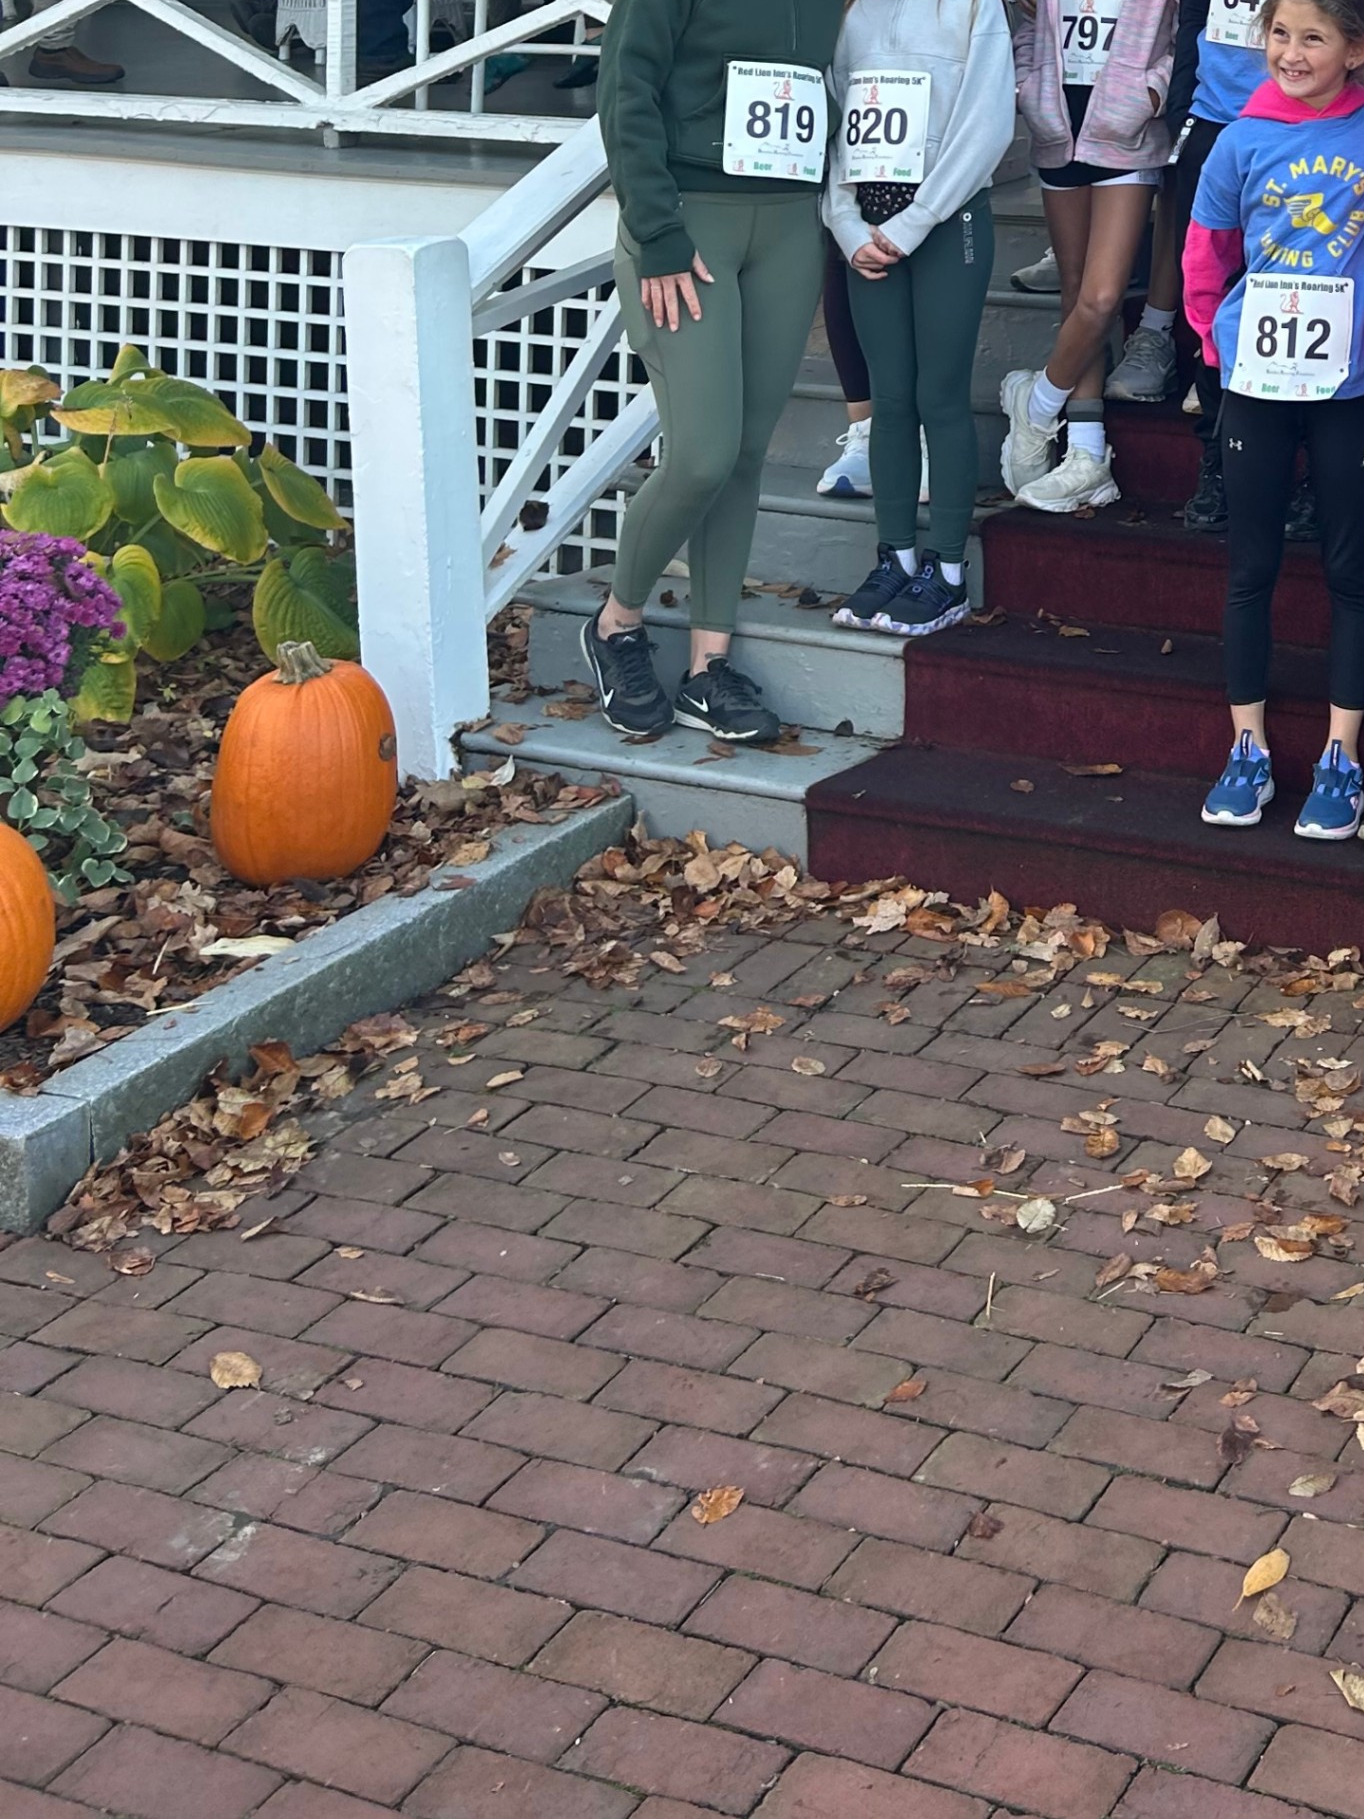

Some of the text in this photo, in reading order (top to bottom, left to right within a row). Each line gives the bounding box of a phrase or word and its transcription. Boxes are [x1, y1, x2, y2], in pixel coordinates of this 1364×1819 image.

[1062, 15, 1118, 52] 797
[746, 100, 815, 143] 819
[846, 107, 908, 146] 820
[893, 167, 912, 177] Food
[1262, 178, 1287, 208] ST.
[1301, 281, 1334, 293] Roaring
[1256, 315, 1331, 360] 812
